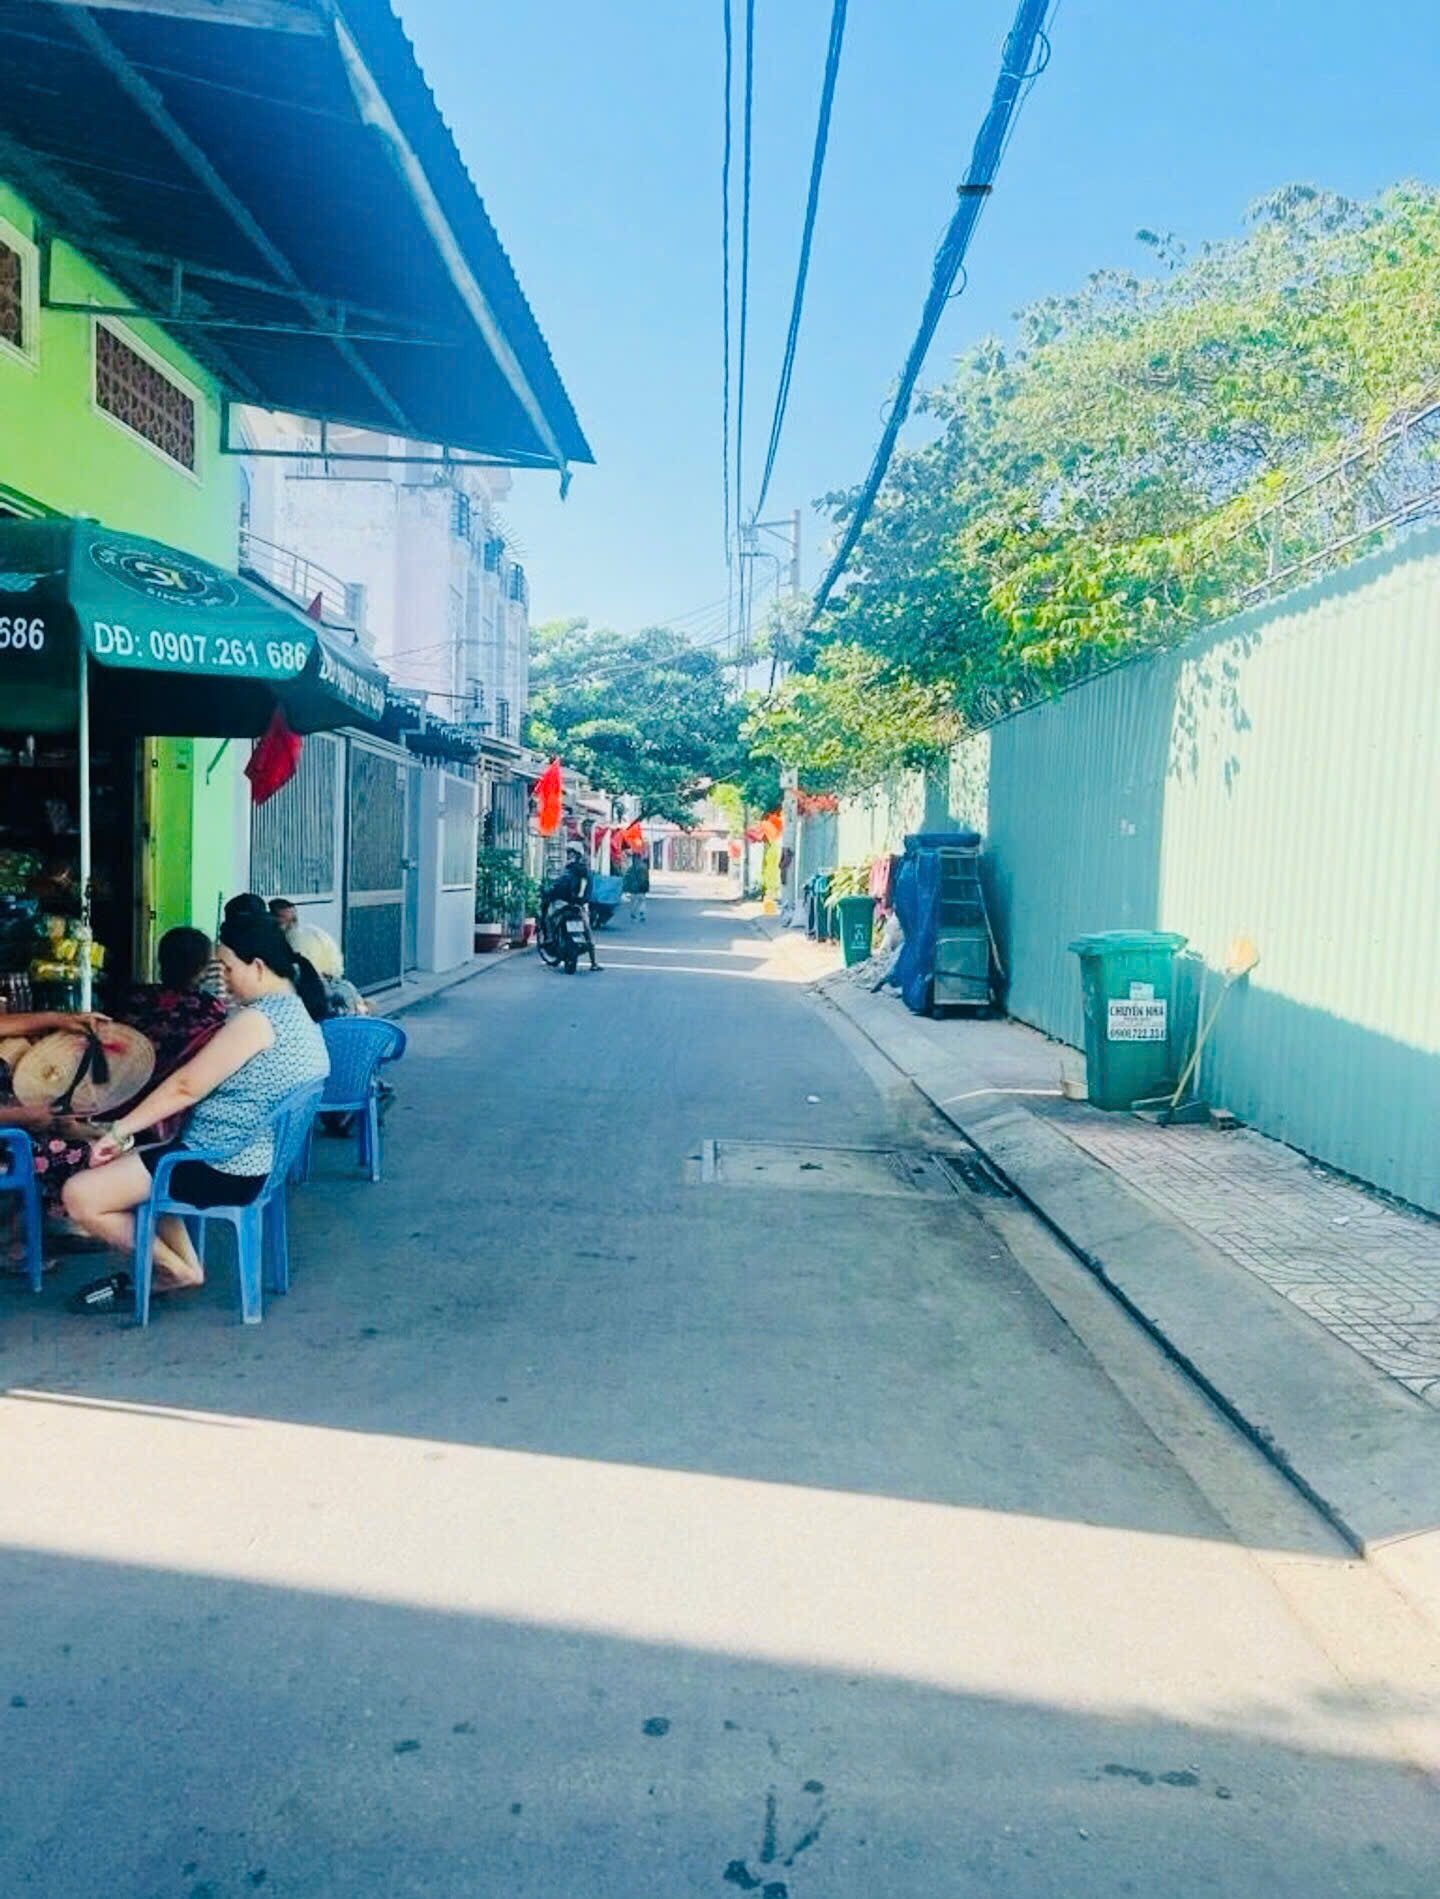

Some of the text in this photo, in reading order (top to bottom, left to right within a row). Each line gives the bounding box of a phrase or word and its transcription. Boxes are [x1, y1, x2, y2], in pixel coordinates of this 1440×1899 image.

[94, 621, 307, 671] DĐ: 0907.261 686
